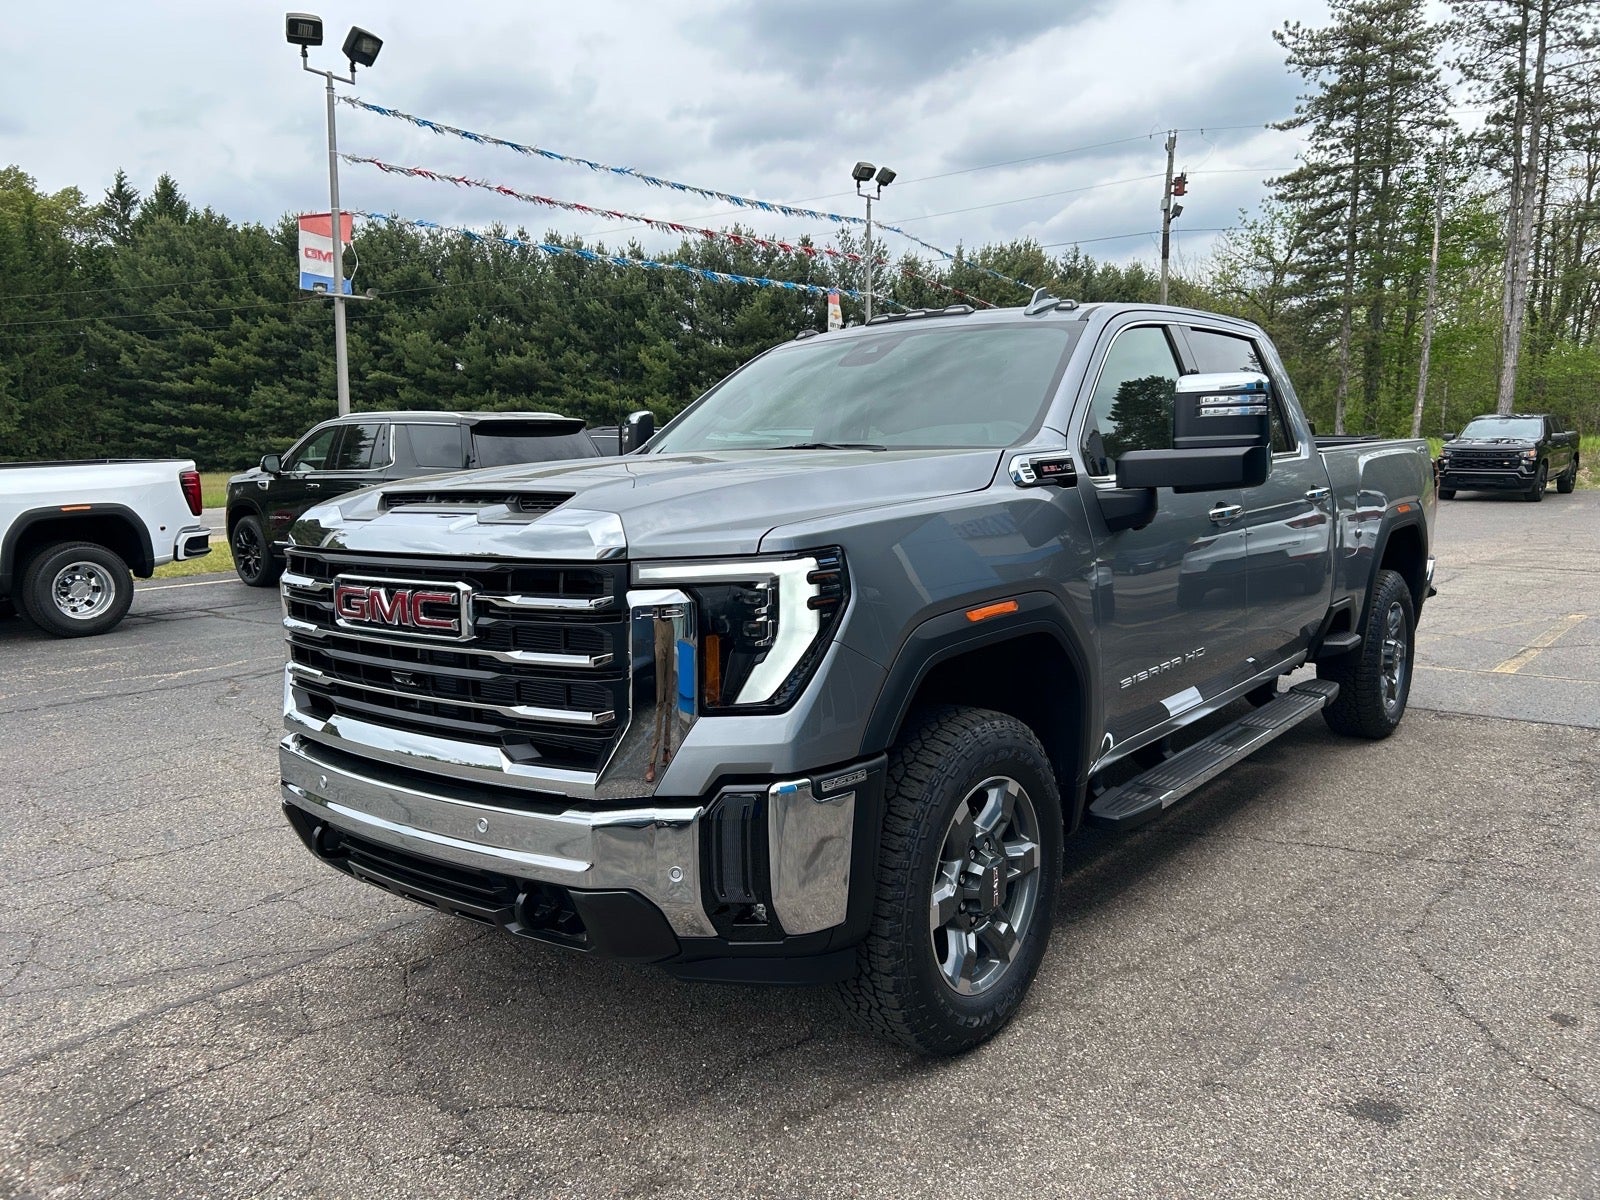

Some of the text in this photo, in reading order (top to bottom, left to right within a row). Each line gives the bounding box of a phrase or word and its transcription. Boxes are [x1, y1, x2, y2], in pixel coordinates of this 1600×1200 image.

[304, 247, 334, 263] GM
[335, 584, 460, 632] GMC
[1119, 646, 1206, 689] SIERRA HD
